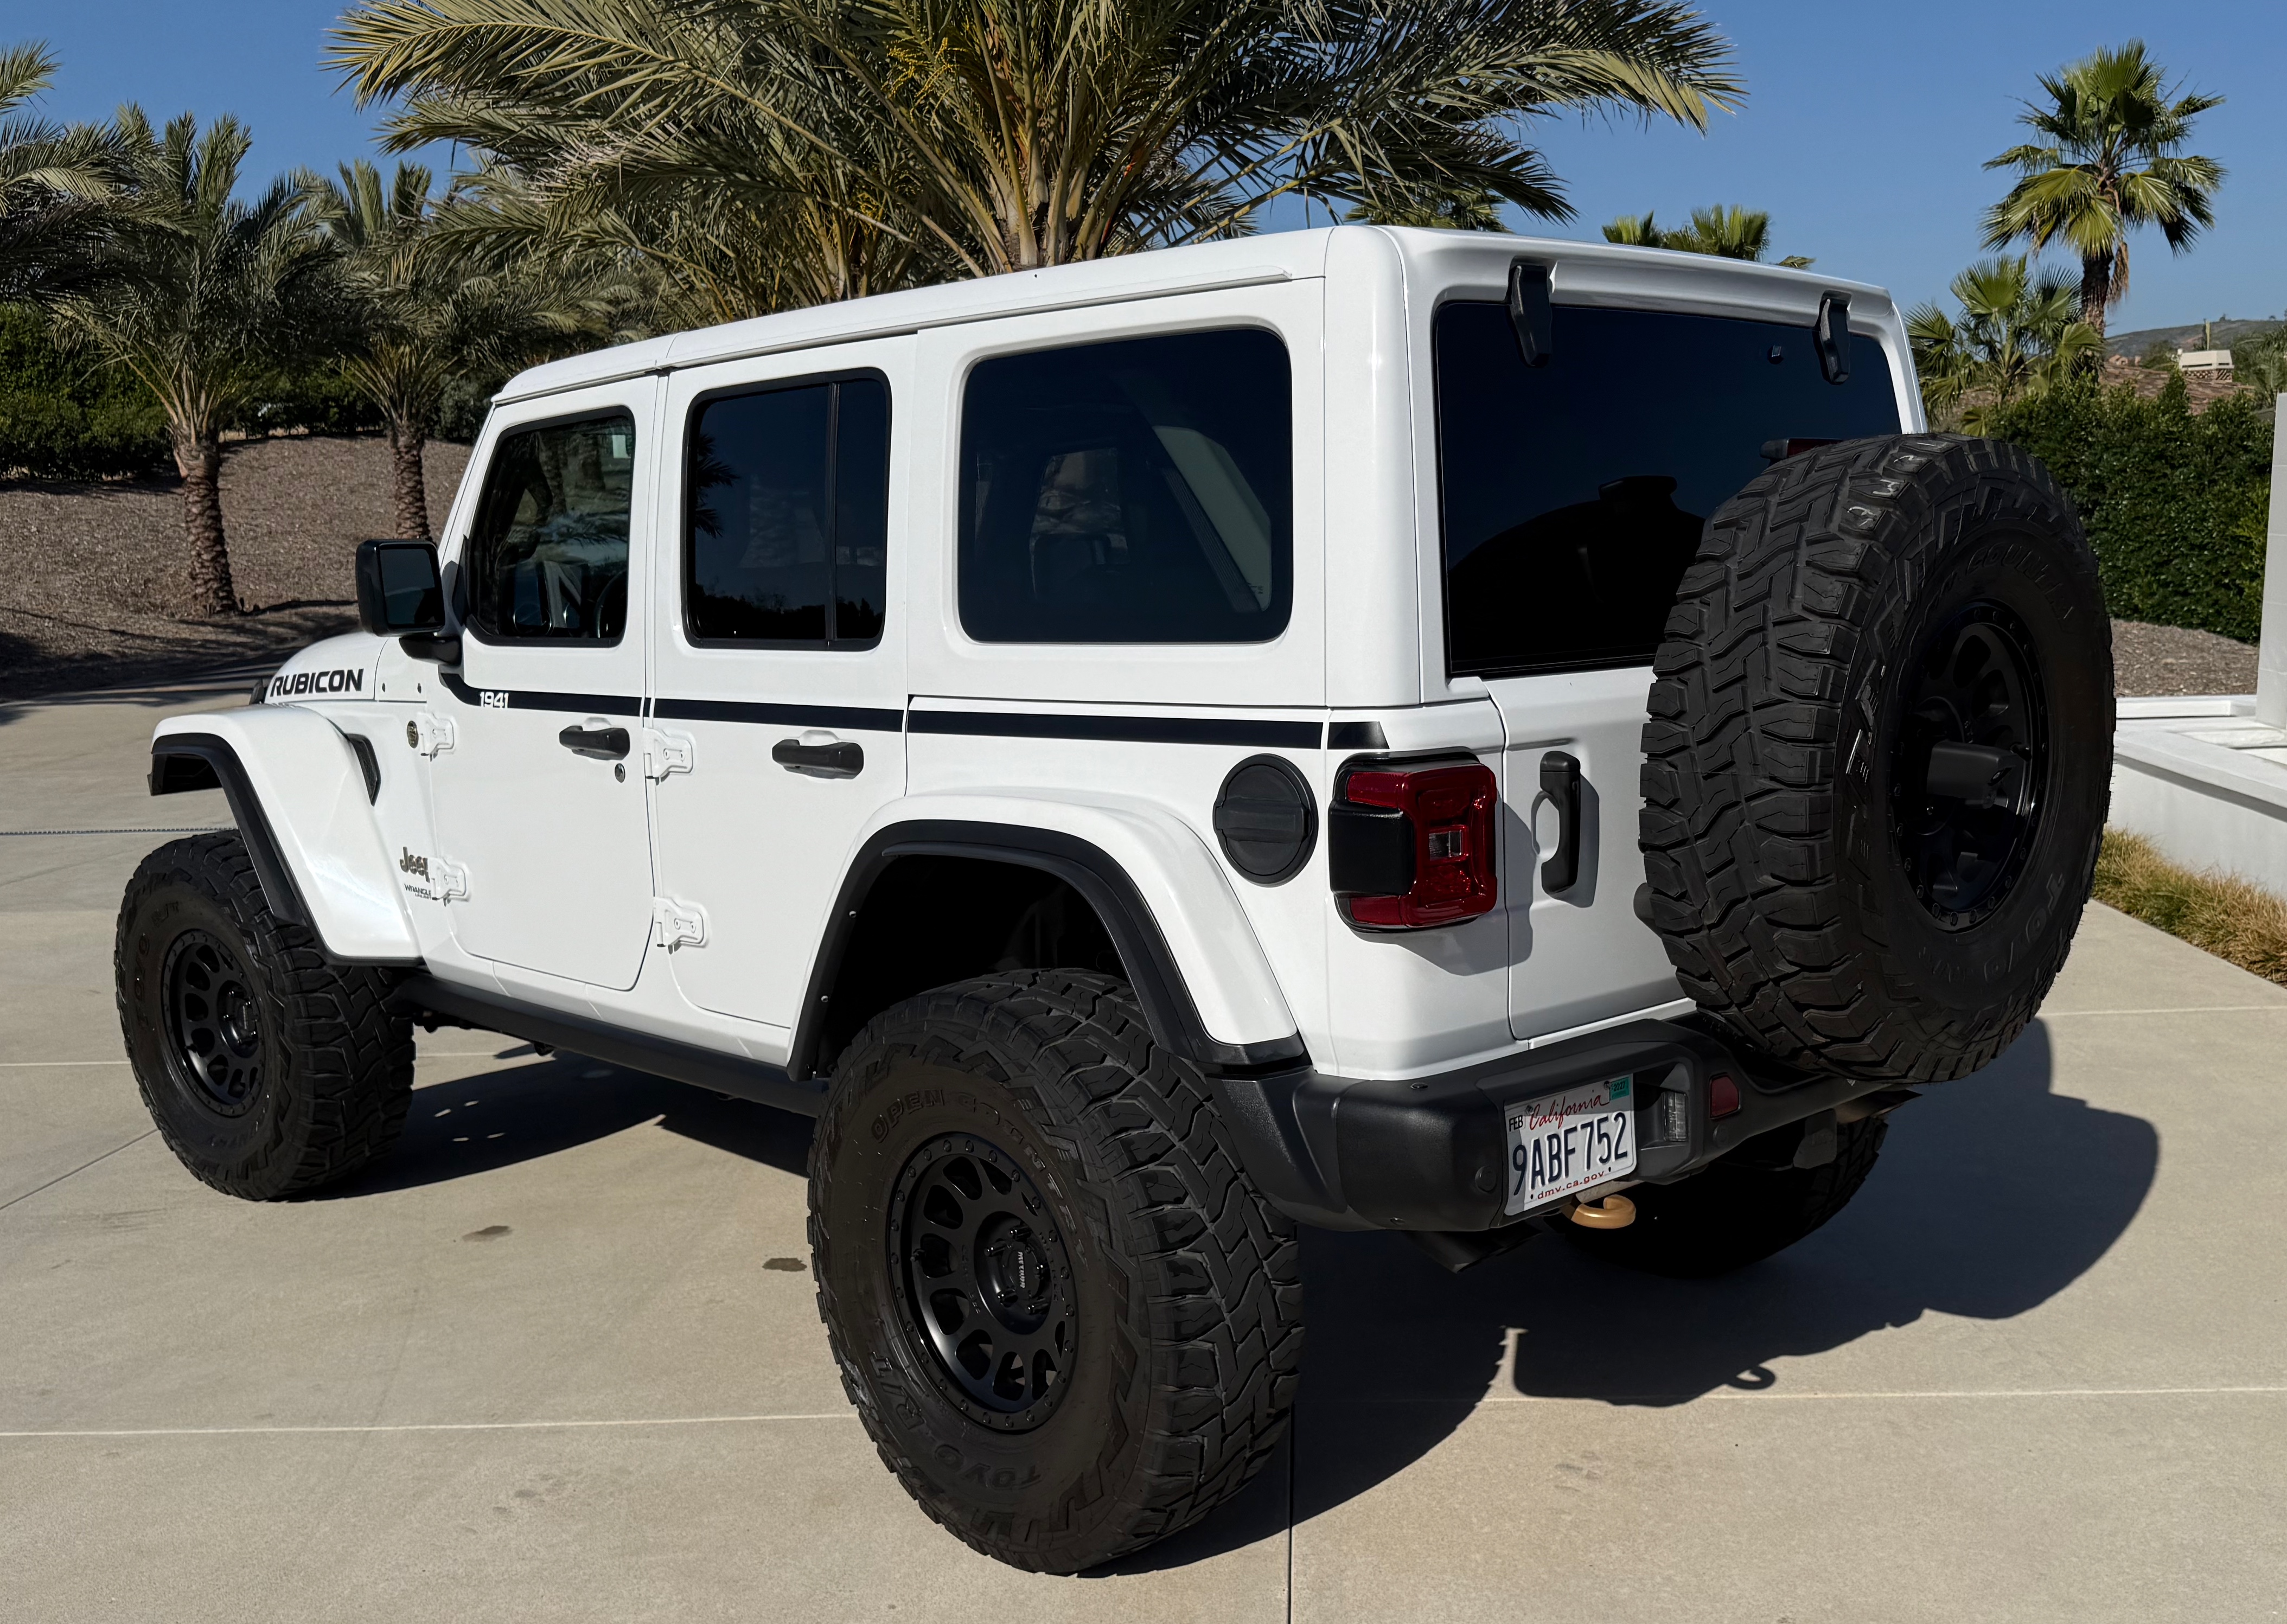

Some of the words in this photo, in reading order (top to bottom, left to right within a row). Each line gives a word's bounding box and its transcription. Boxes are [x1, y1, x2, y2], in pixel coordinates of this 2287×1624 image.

[271, 669, 363, 696] RUBICON
[480, 692, 508, 708] 1941
[404, 884, 431, 896] WRANGLE
[871, 1089, 944, 1143] OPEN
[1509, 1115, 1523, 1131] FEB
[1529, 1091, 1609, 1130] California
[1512, 1112, 1627, 1195] 9ABF752
[1537, 1171, 1605, 1199] dmv.ca.gov
[934, 1444, 1042, 1489] TOYO
